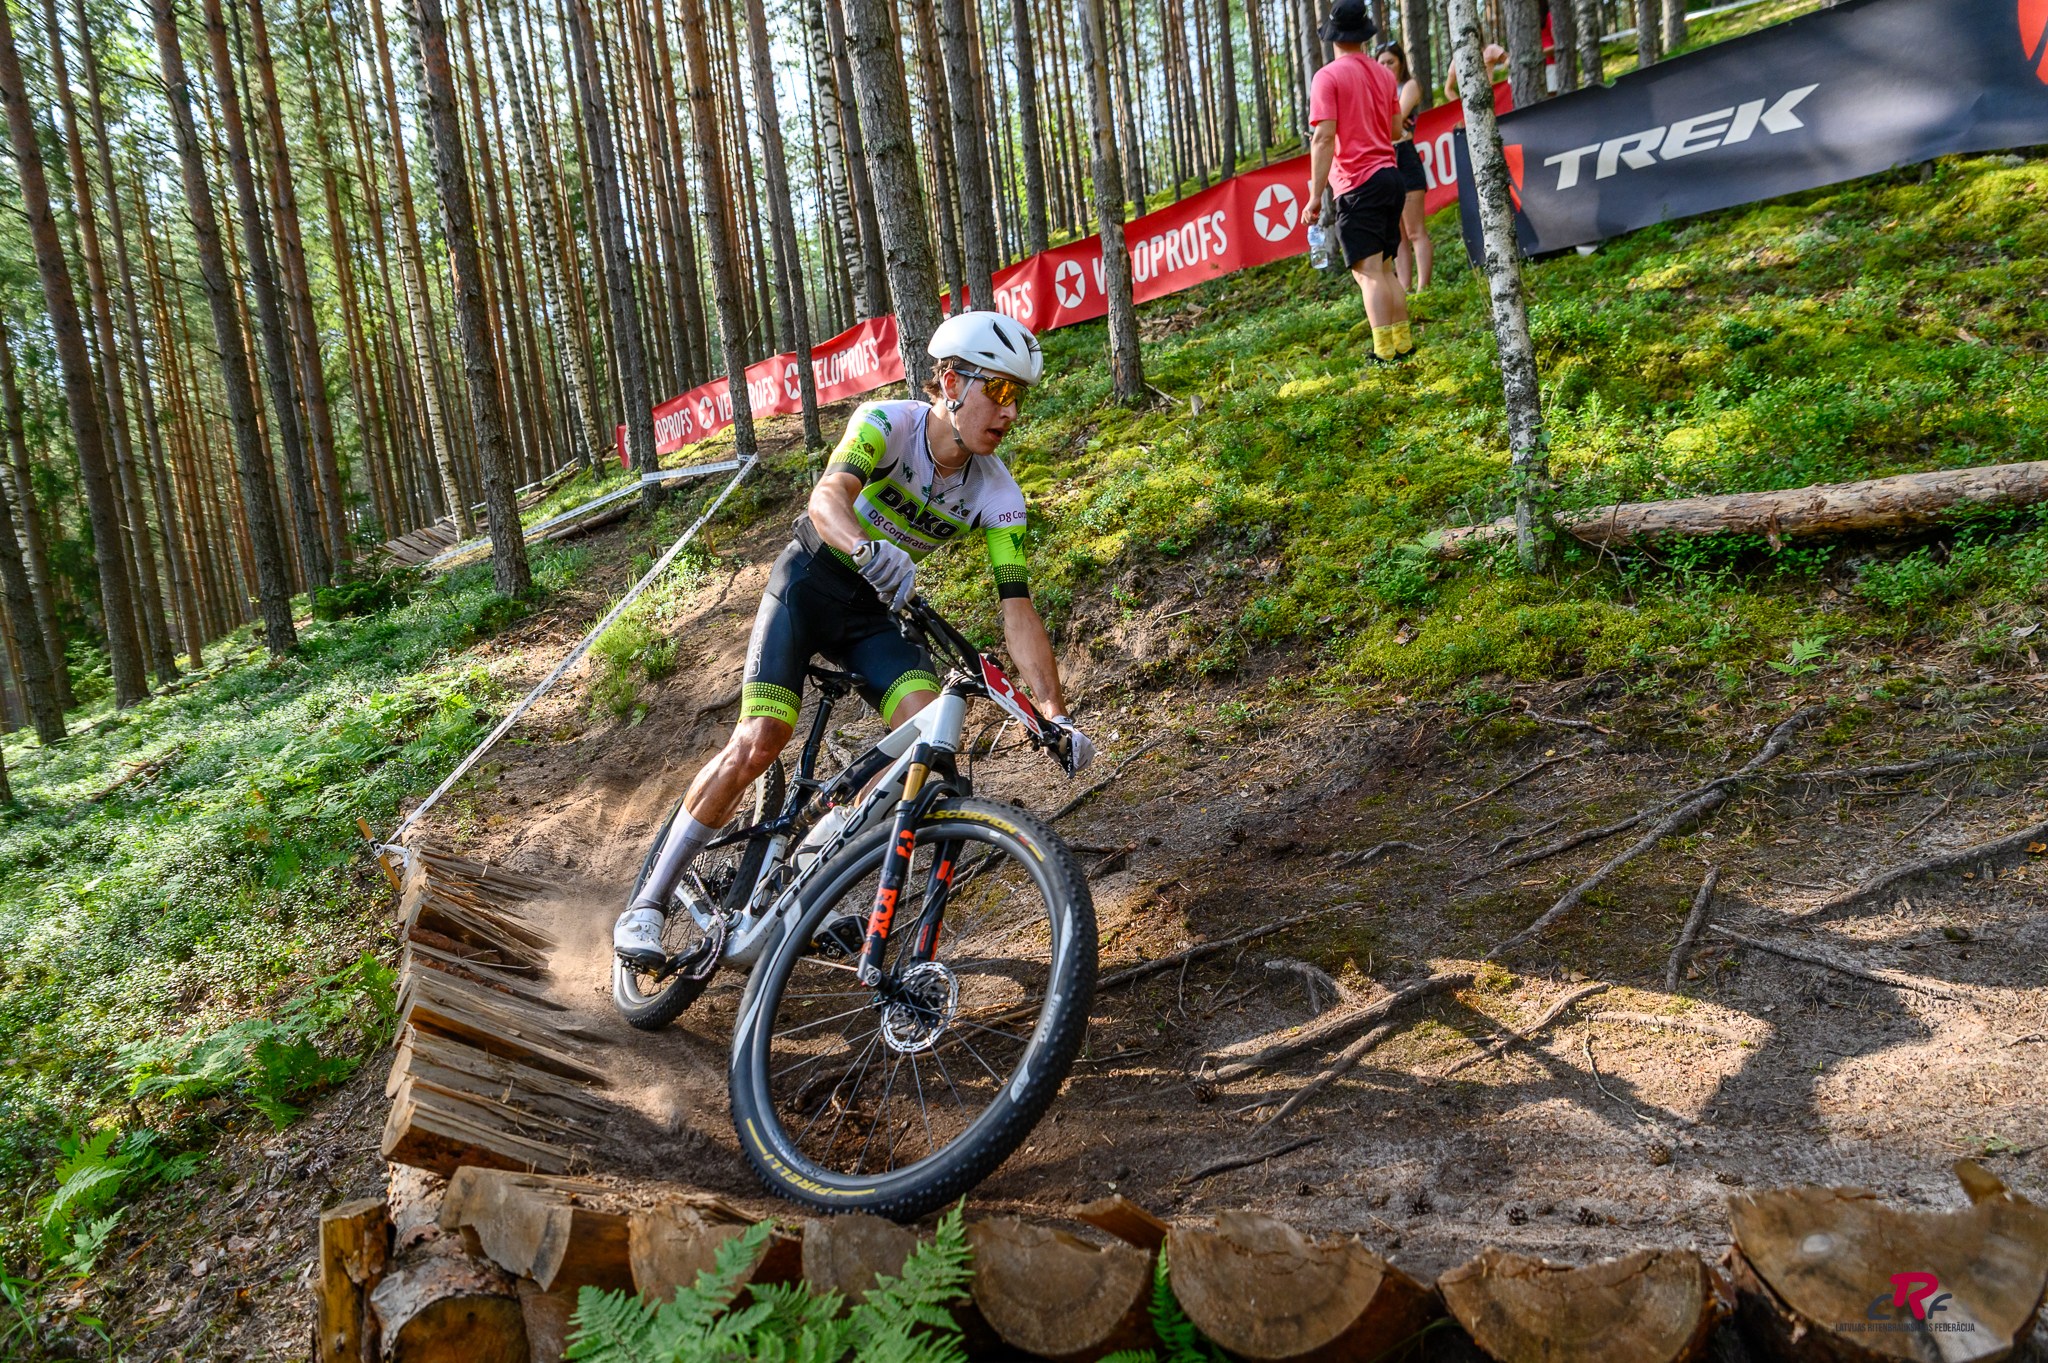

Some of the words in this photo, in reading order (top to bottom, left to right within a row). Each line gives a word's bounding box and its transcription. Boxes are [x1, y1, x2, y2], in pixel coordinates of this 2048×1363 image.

[1544, 83, 1820, 191] TREK
[1092, 210, 1228, 295] VOPROFS
[868, 509, 884, 527] D8
[875, 484, 960, 539] DAKO
[999, 511, 1012, 523] D8
[936, 810, 1017, 834] SCORPION
[867, 887, 898, 939] FOX
[763, 1153, 833, 1195] PIRELLI
